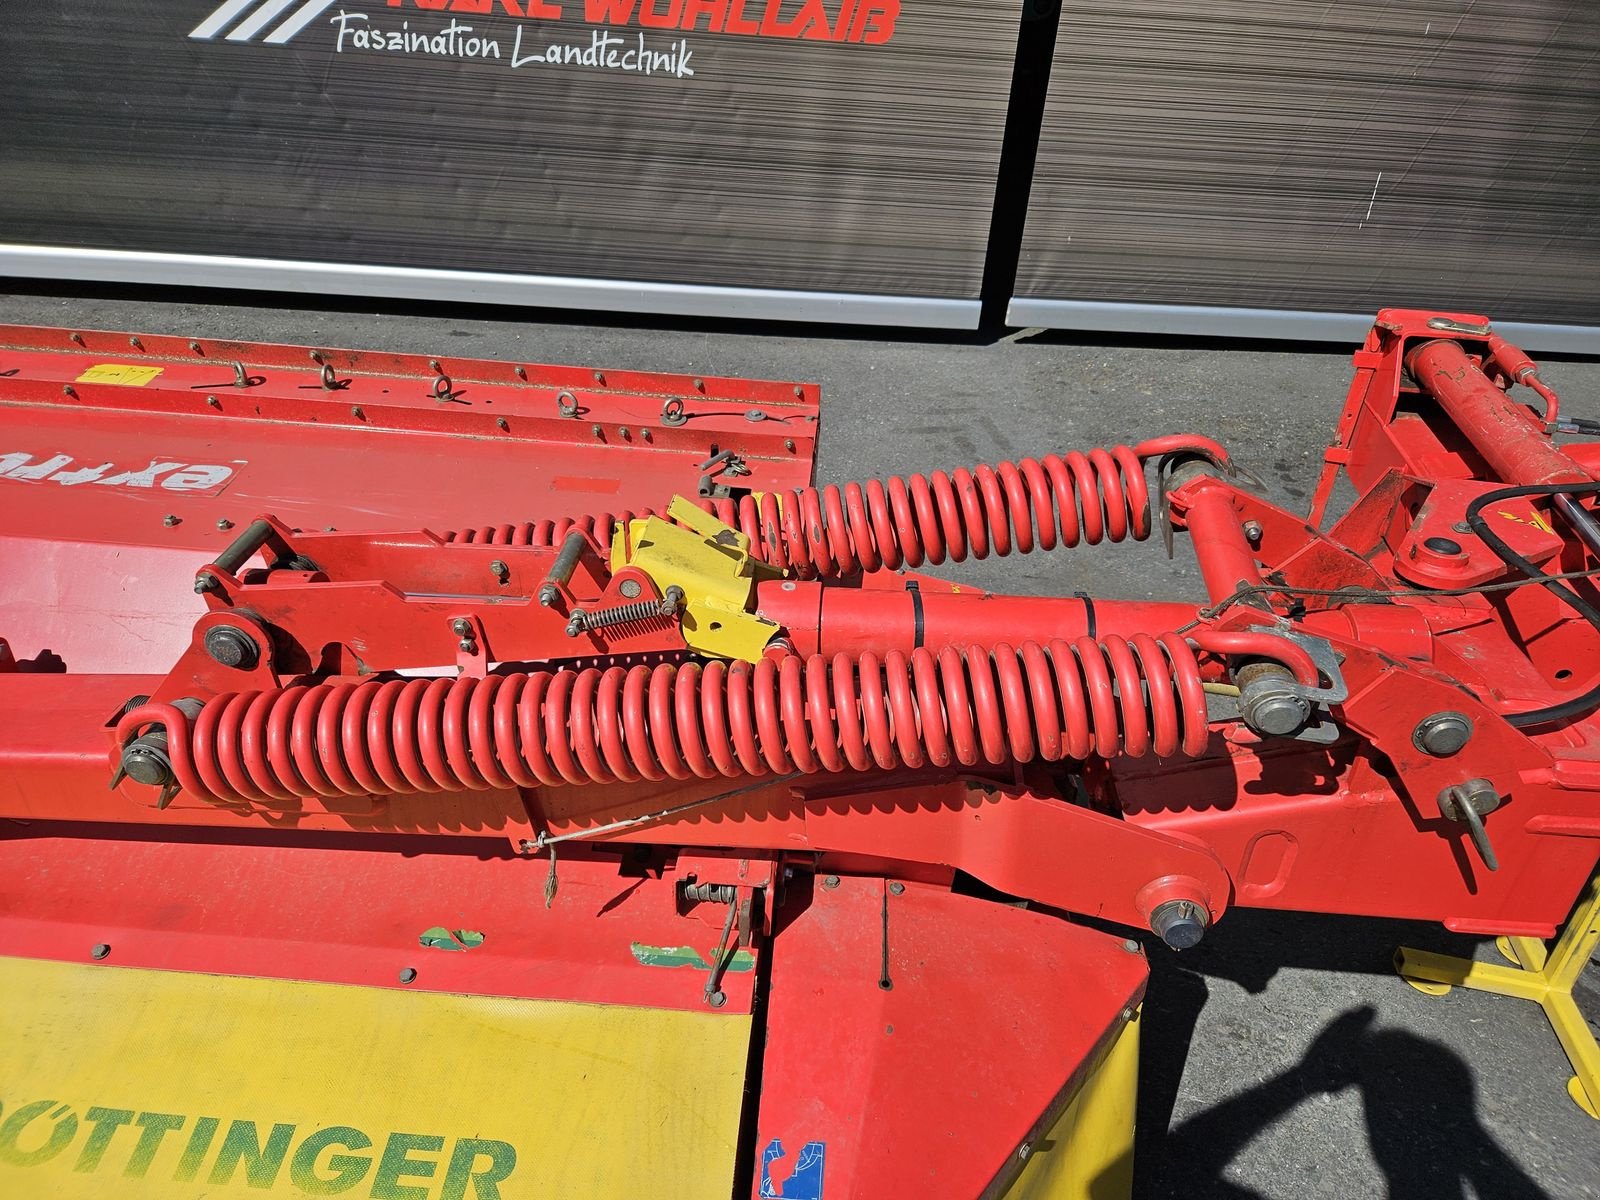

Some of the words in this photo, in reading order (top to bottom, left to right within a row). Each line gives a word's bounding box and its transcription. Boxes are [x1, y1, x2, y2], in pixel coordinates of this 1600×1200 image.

[330, 9, 500, 59] Faszination
[511, 24, 694, 78] Landtechnik
[0, 1099, 517, 1200] ÖTTINGER
